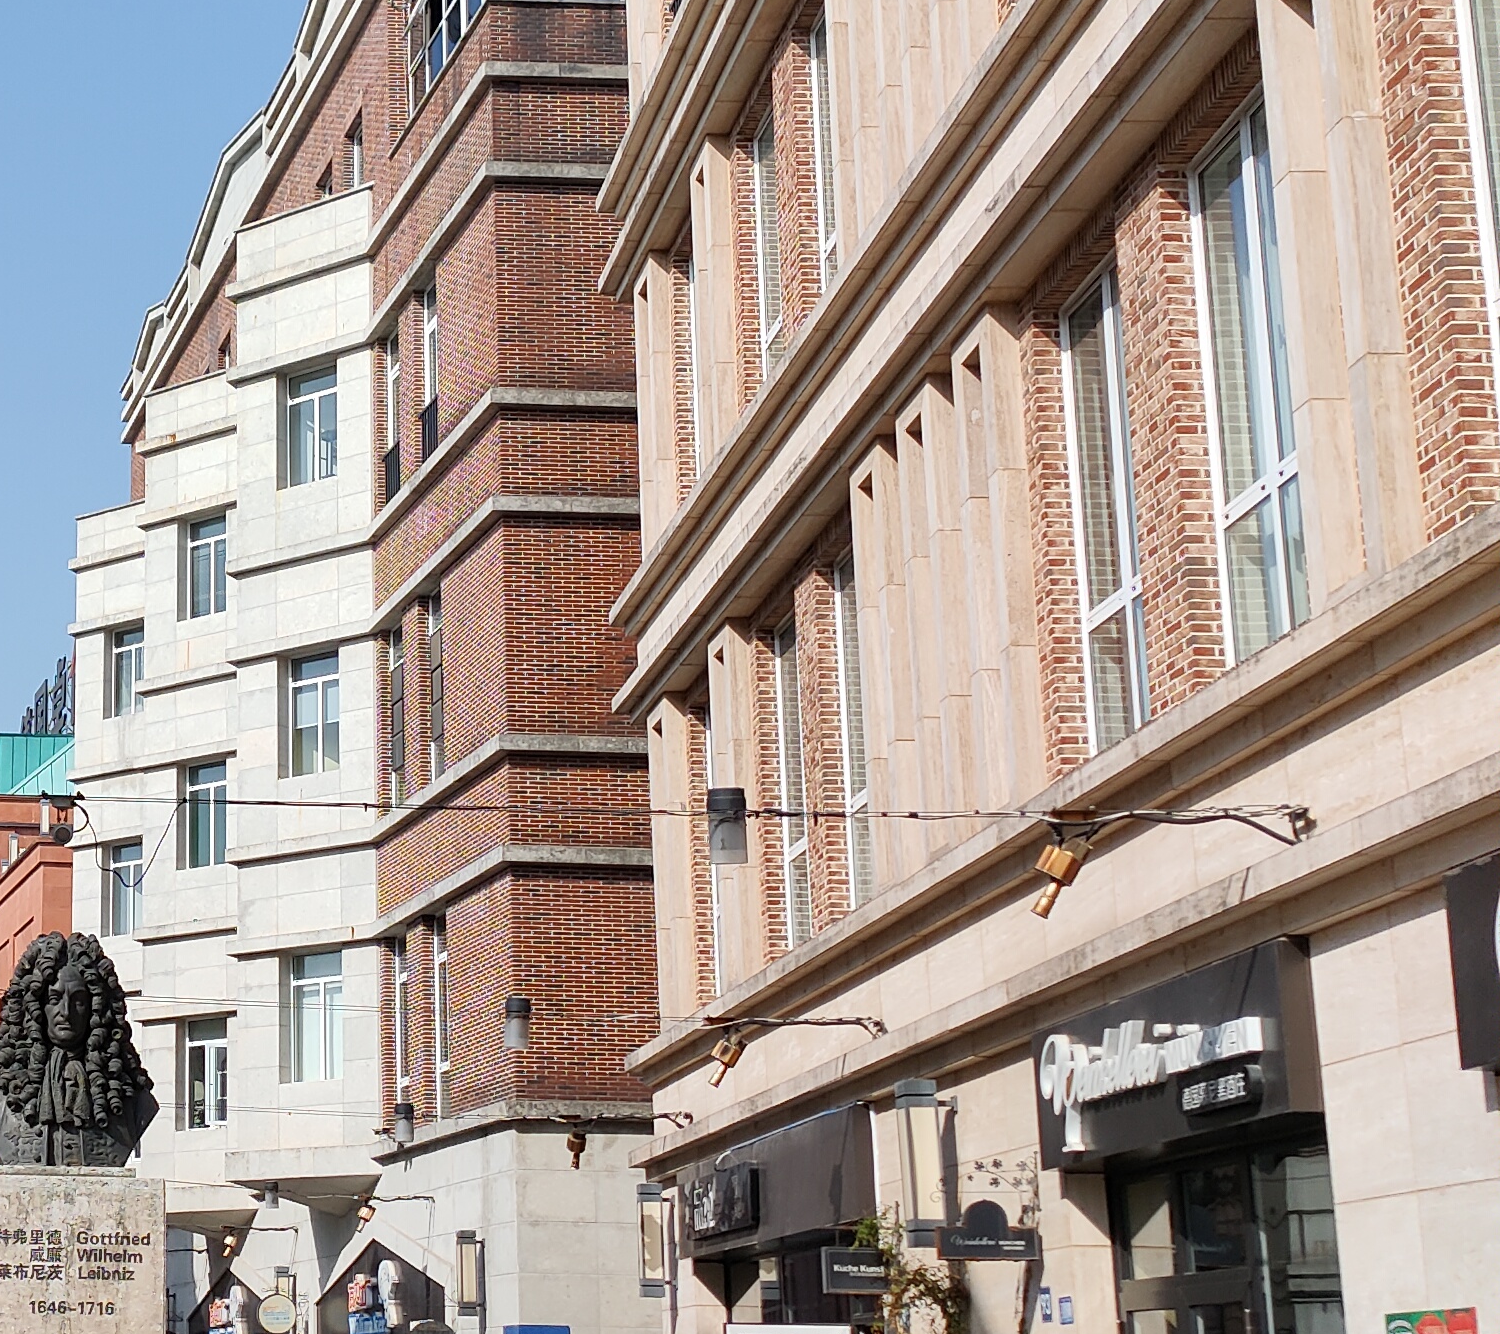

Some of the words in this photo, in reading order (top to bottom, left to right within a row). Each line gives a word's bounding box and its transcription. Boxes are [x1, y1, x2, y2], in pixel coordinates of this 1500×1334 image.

[76, 1230, 151, 1246] Gottfried
[28, 1246, 64, 1263] 威廉
[76, 1247, 143, 1264] Wilhelm
[77, 1265, 135, 1281] Leibniz
